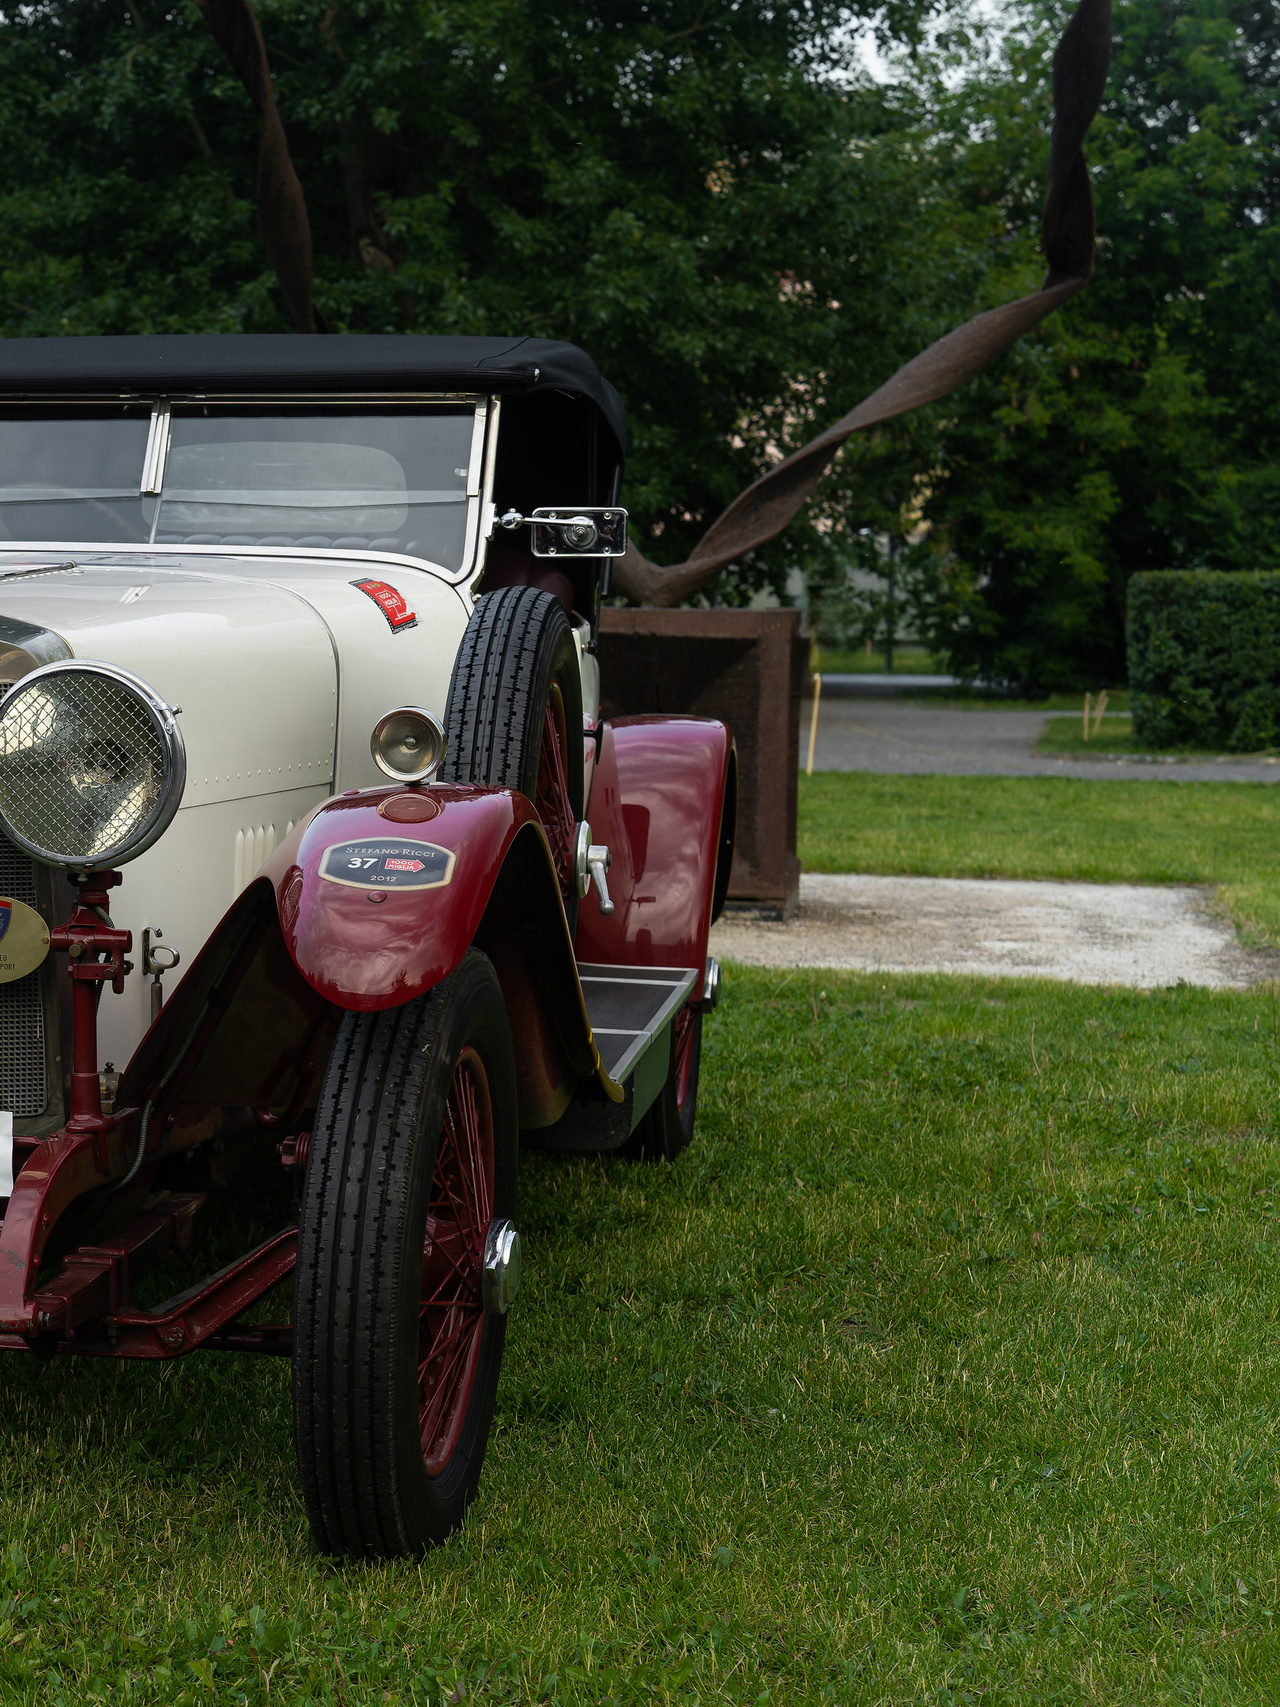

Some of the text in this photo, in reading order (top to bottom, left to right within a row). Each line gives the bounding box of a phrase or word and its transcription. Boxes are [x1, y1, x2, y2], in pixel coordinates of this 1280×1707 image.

[345, 847, 436, 858] STEFANO RICCI
[347, 857, 379, 869] 37
